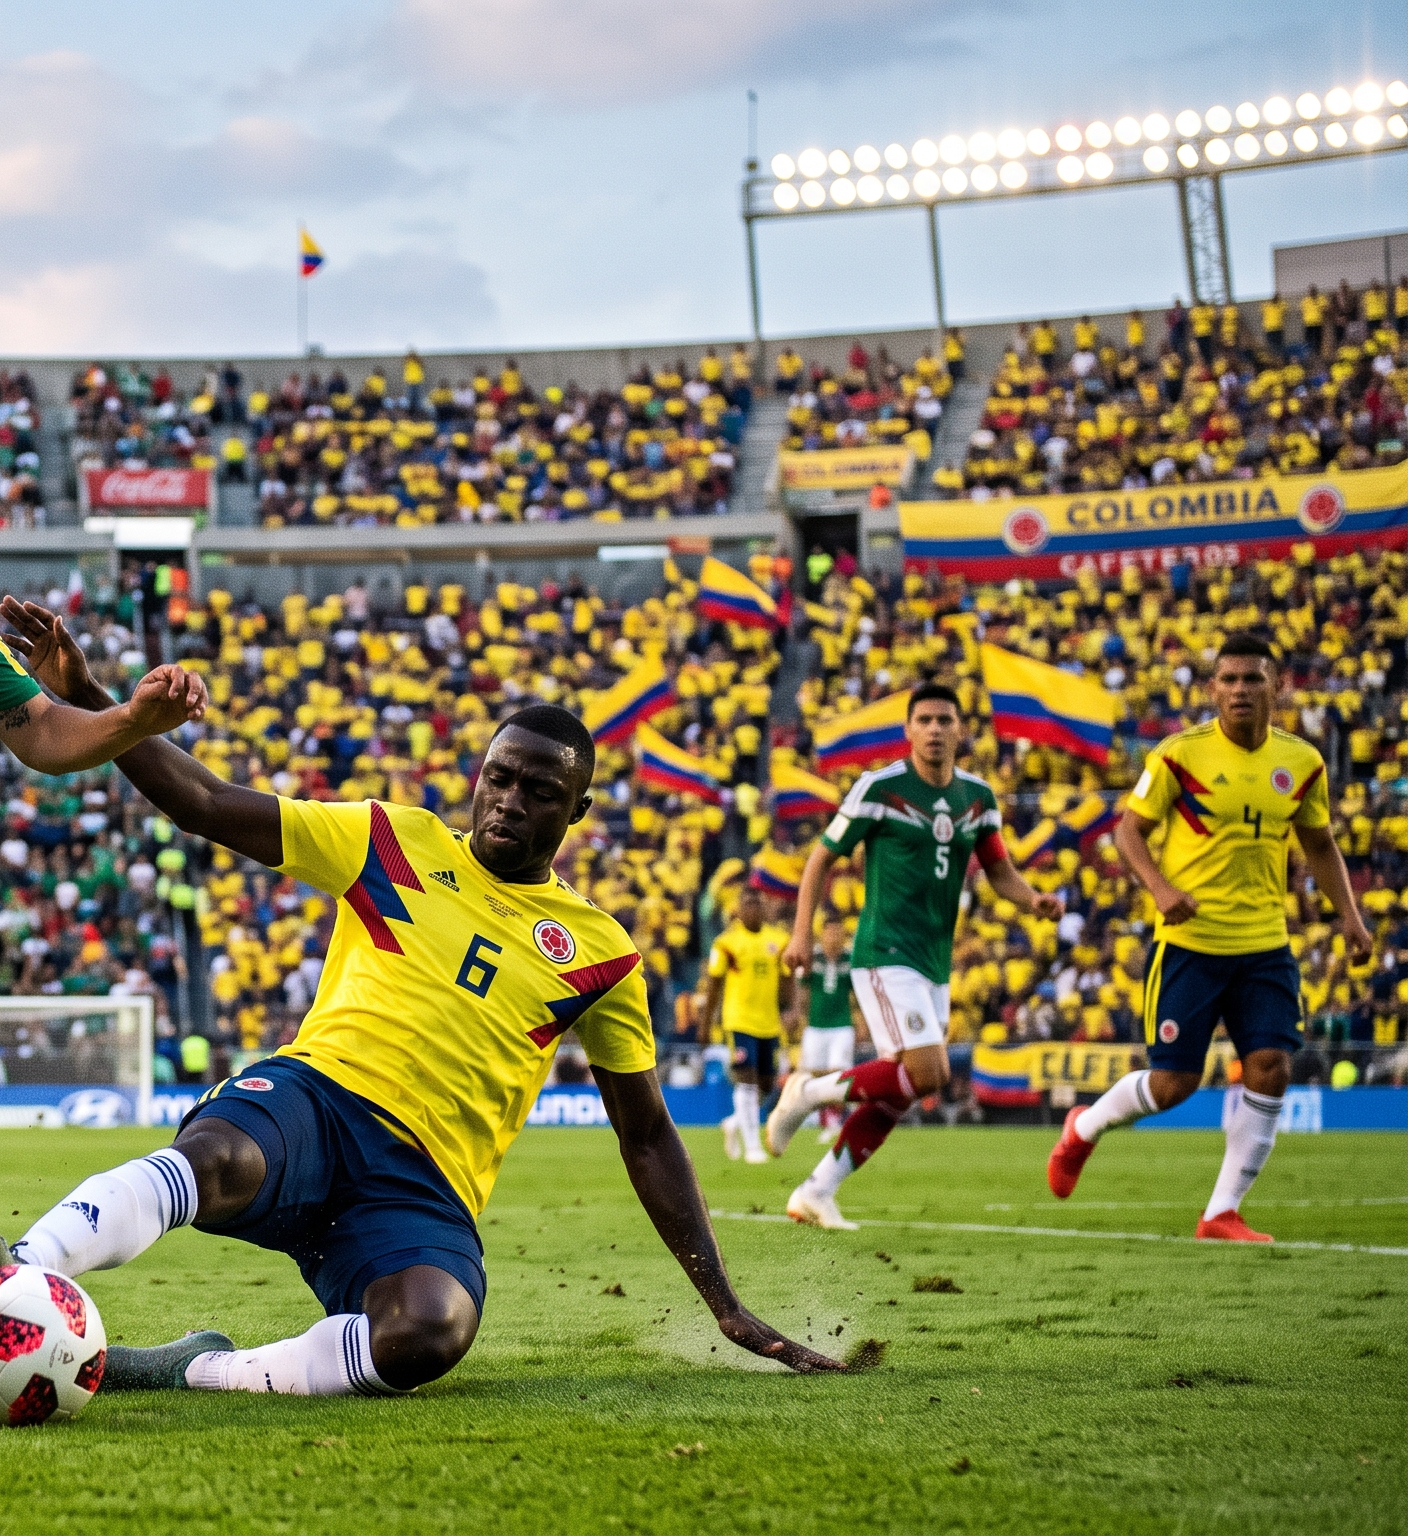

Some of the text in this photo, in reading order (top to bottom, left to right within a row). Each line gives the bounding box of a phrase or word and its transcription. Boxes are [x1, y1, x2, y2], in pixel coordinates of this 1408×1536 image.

[1066, 487, 1281, 529] COLOMBIA
[1243, 804, 1262, 839] 4
[934, 845, 950, 879] 5
[454, 932, 503, 999] 6
